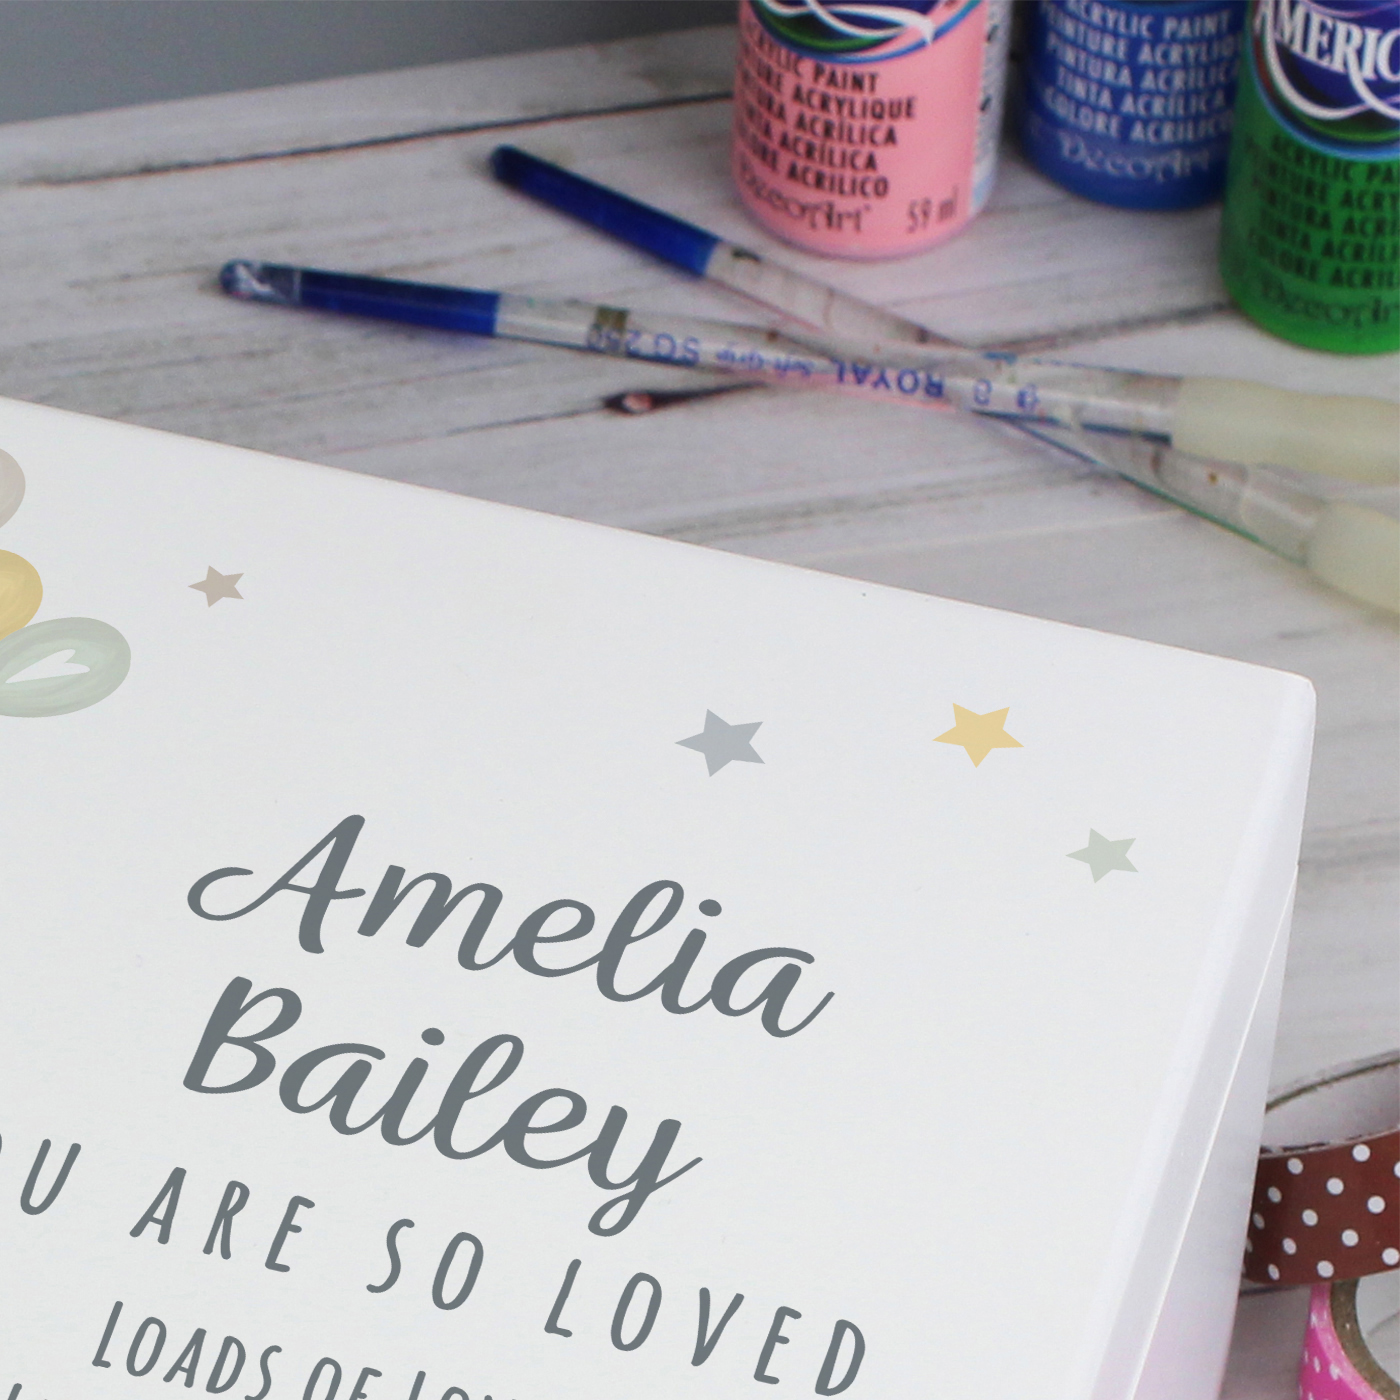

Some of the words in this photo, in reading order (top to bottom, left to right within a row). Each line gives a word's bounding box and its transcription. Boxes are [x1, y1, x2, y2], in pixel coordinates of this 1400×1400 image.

[1163, 9, 1230, 41] PAINT
[813, 62, 879, 94] PAINT
[792, 82, 917, 120] ACRYLIQUE
[786, 161, 889, 199] ACRILICO
[906, 197, 932, 234] 59
[831, 357, 946, 399] ROYAL
[188, 815, 835, 1038] Amelia
[183, 976, 703, 1237] Bailey
[130, 1167, 315, 1272] ARE
[367, 1219, 483, 1310] SO
[544, 1259, 865, 1396] LOVED
